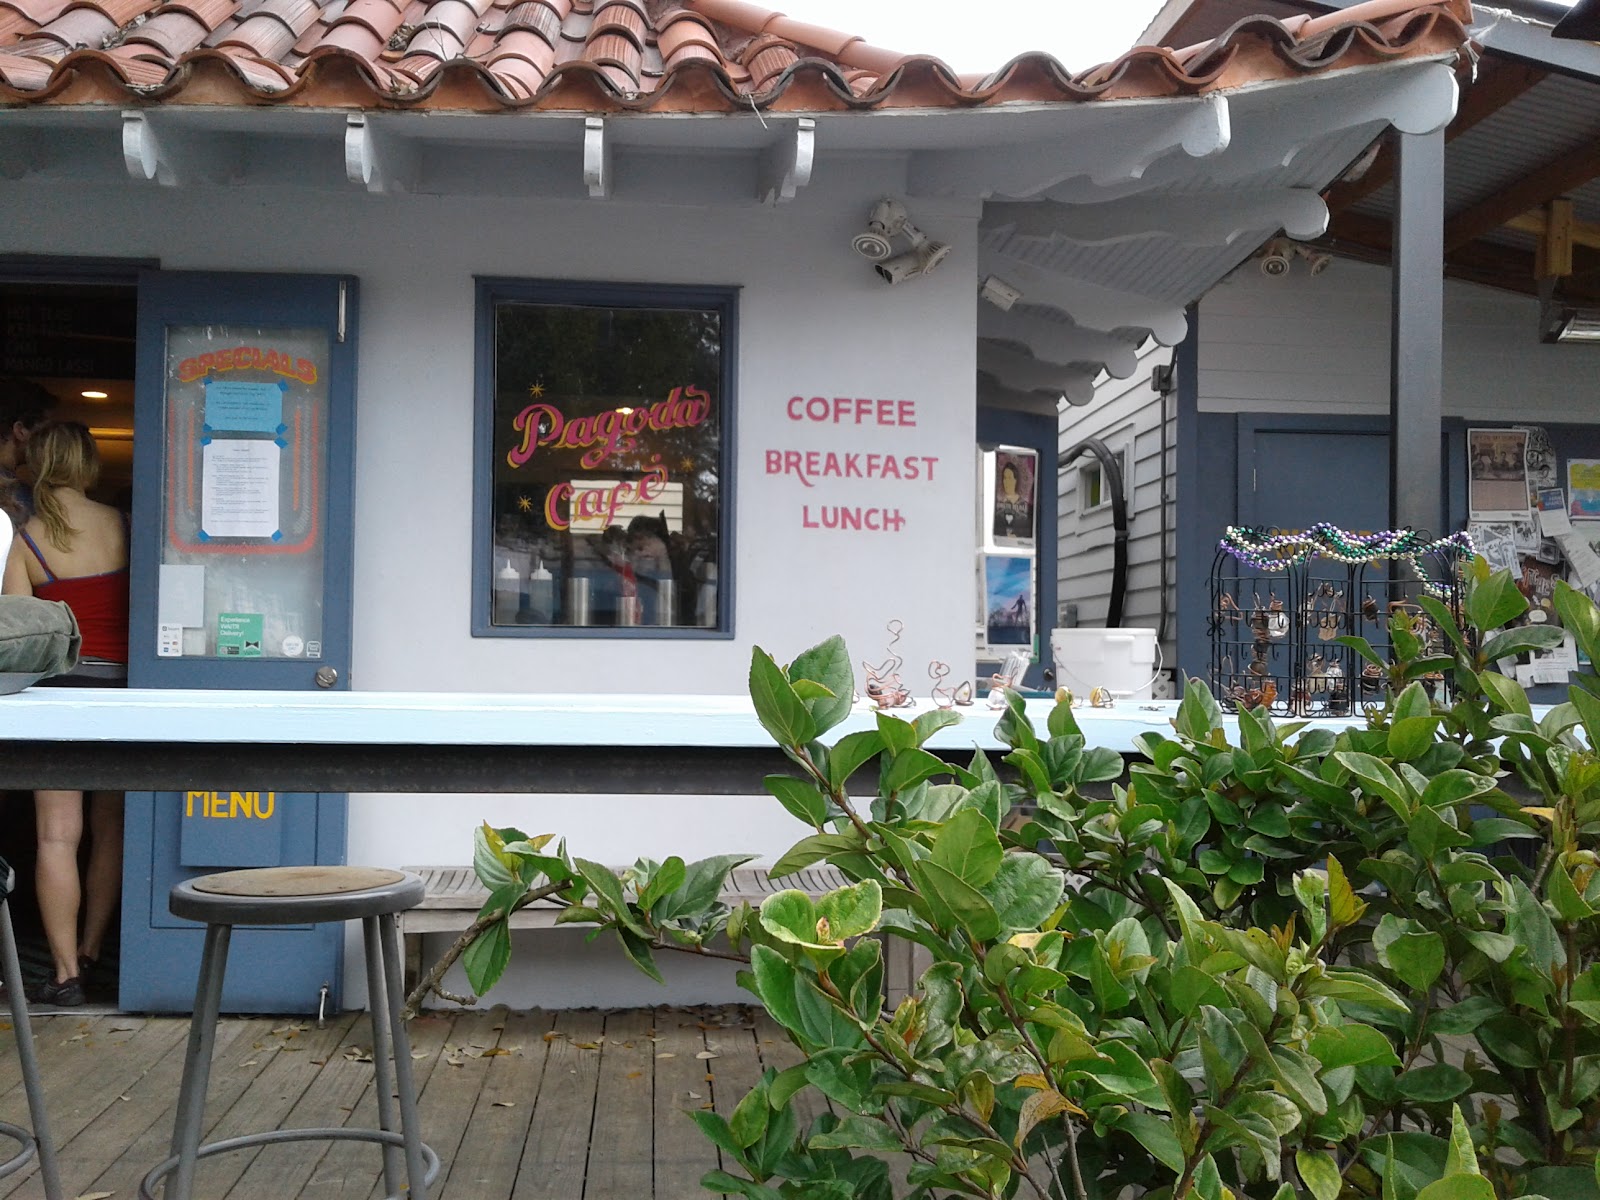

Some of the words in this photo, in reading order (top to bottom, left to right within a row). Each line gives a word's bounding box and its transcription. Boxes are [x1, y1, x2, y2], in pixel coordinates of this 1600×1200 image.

[178, 346, 318, 385] SPECIALS
[507, 384, 711, 469] Pagoda
[787, 396, 917, 427] COFFEE
[765, 449, 939, 487] BREAKFAST
[802, 505, 906, 532] LUNCH
[186, 791, 275, 819] MENU
